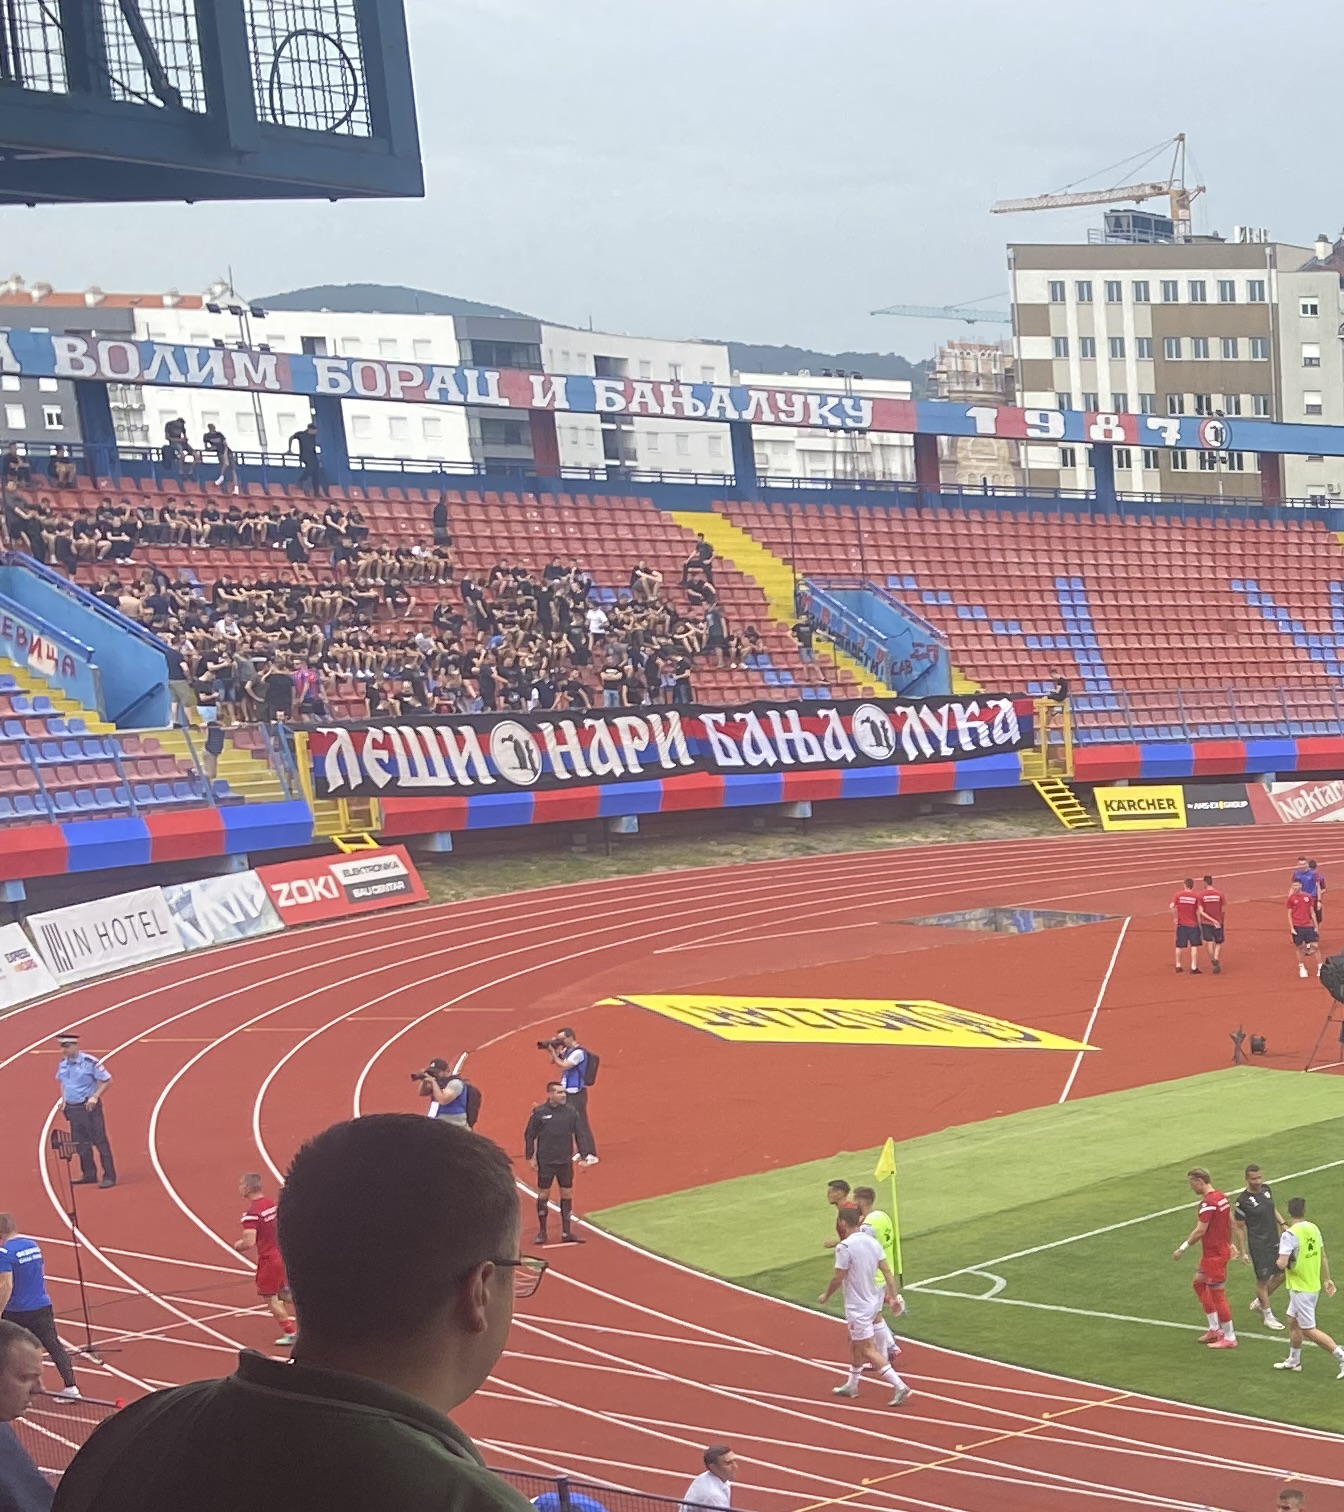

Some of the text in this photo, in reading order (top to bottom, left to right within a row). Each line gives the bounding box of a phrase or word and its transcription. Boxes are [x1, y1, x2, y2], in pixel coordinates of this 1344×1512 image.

[51, 334, 281, 391] ВОЛИМ
[312, 357, 509, 407] БОРАЦ
[529, 374, 569, 410] И
[593, 378, 873, 429] БАЊАЛУКУ
[1277, 780, 1344, 823] Nektar
[272, 875, 339, 908] ZOKI
[65, 926, 92, 959] IN
[95, 909, 168, 950] HOTEL
[666, 1004, 955, 1033] MOZZART
